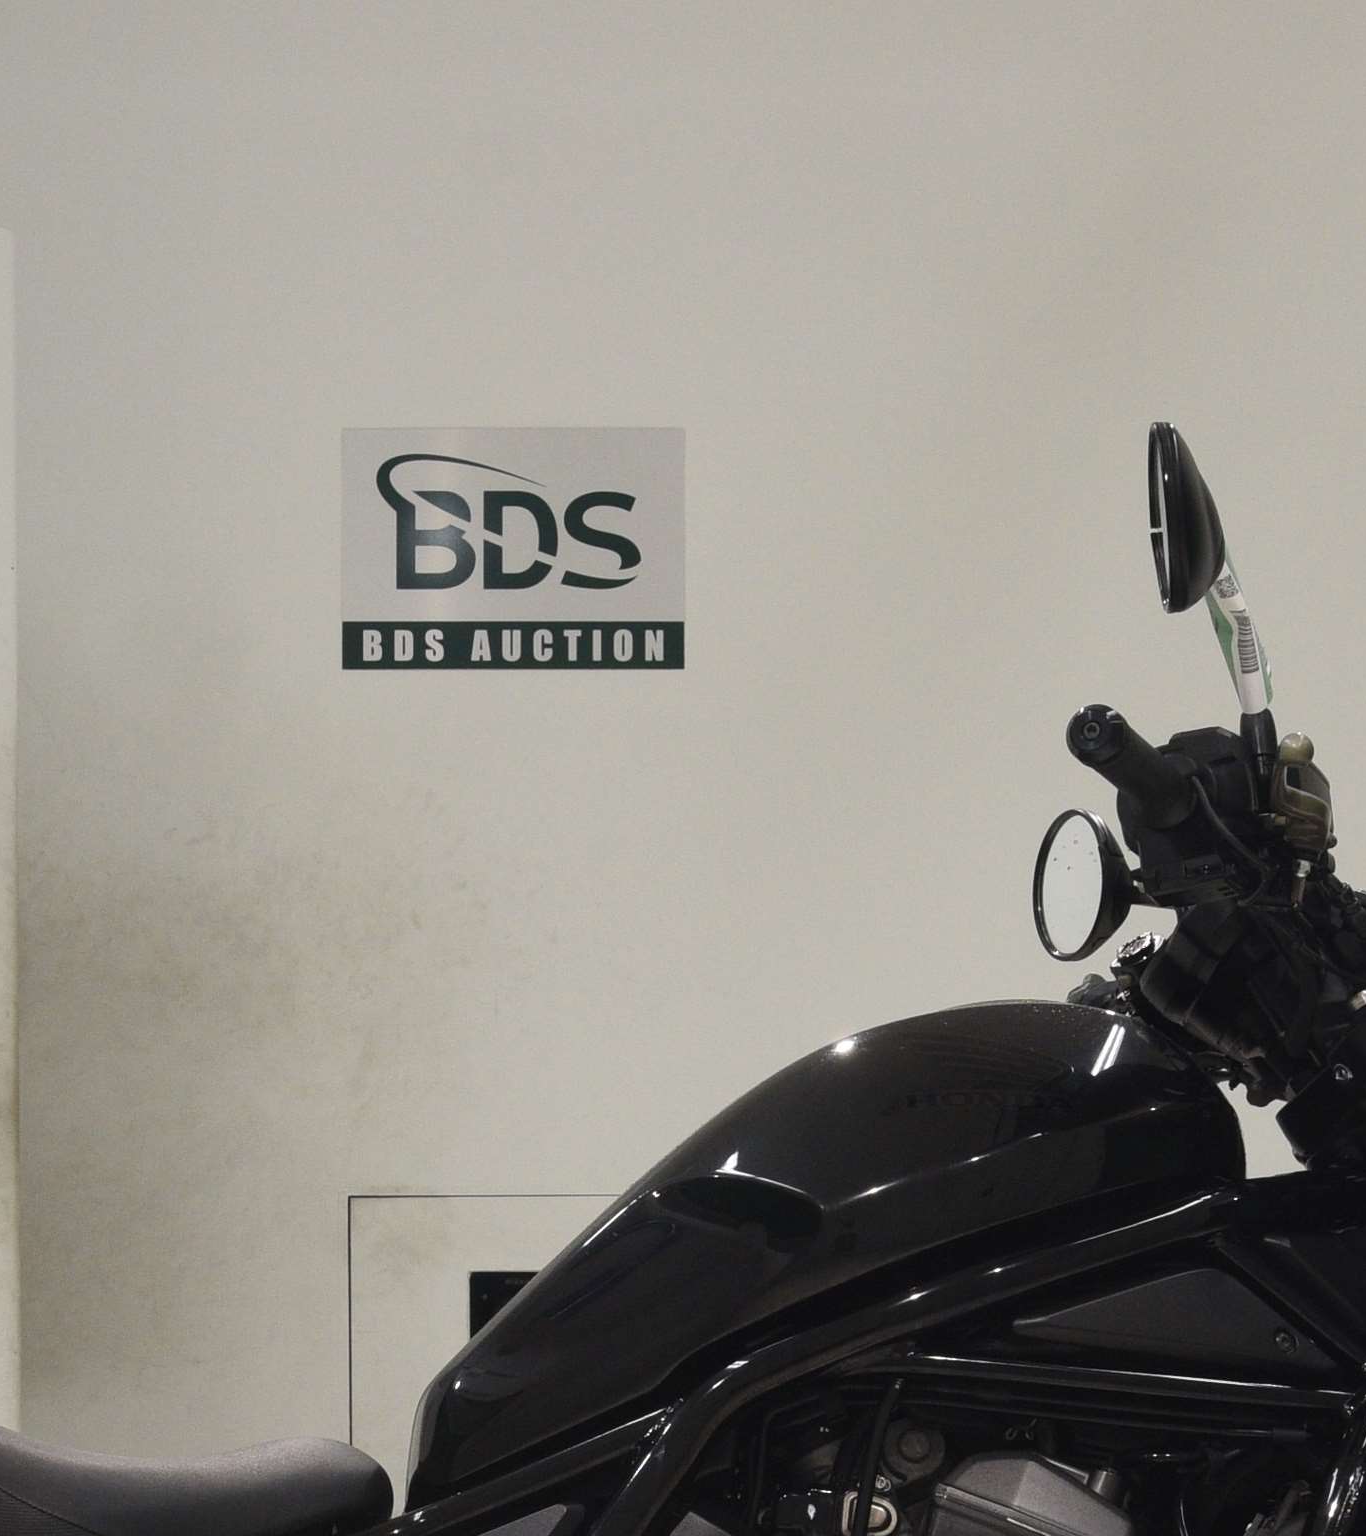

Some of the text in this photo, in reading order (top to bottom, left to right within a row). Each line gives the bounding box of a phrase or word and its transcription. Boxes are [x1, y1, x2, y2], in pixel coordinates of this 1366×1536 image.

[376, 454, 642, 590] BDS
[362, 629, 665, 662] BDS AUCTION
